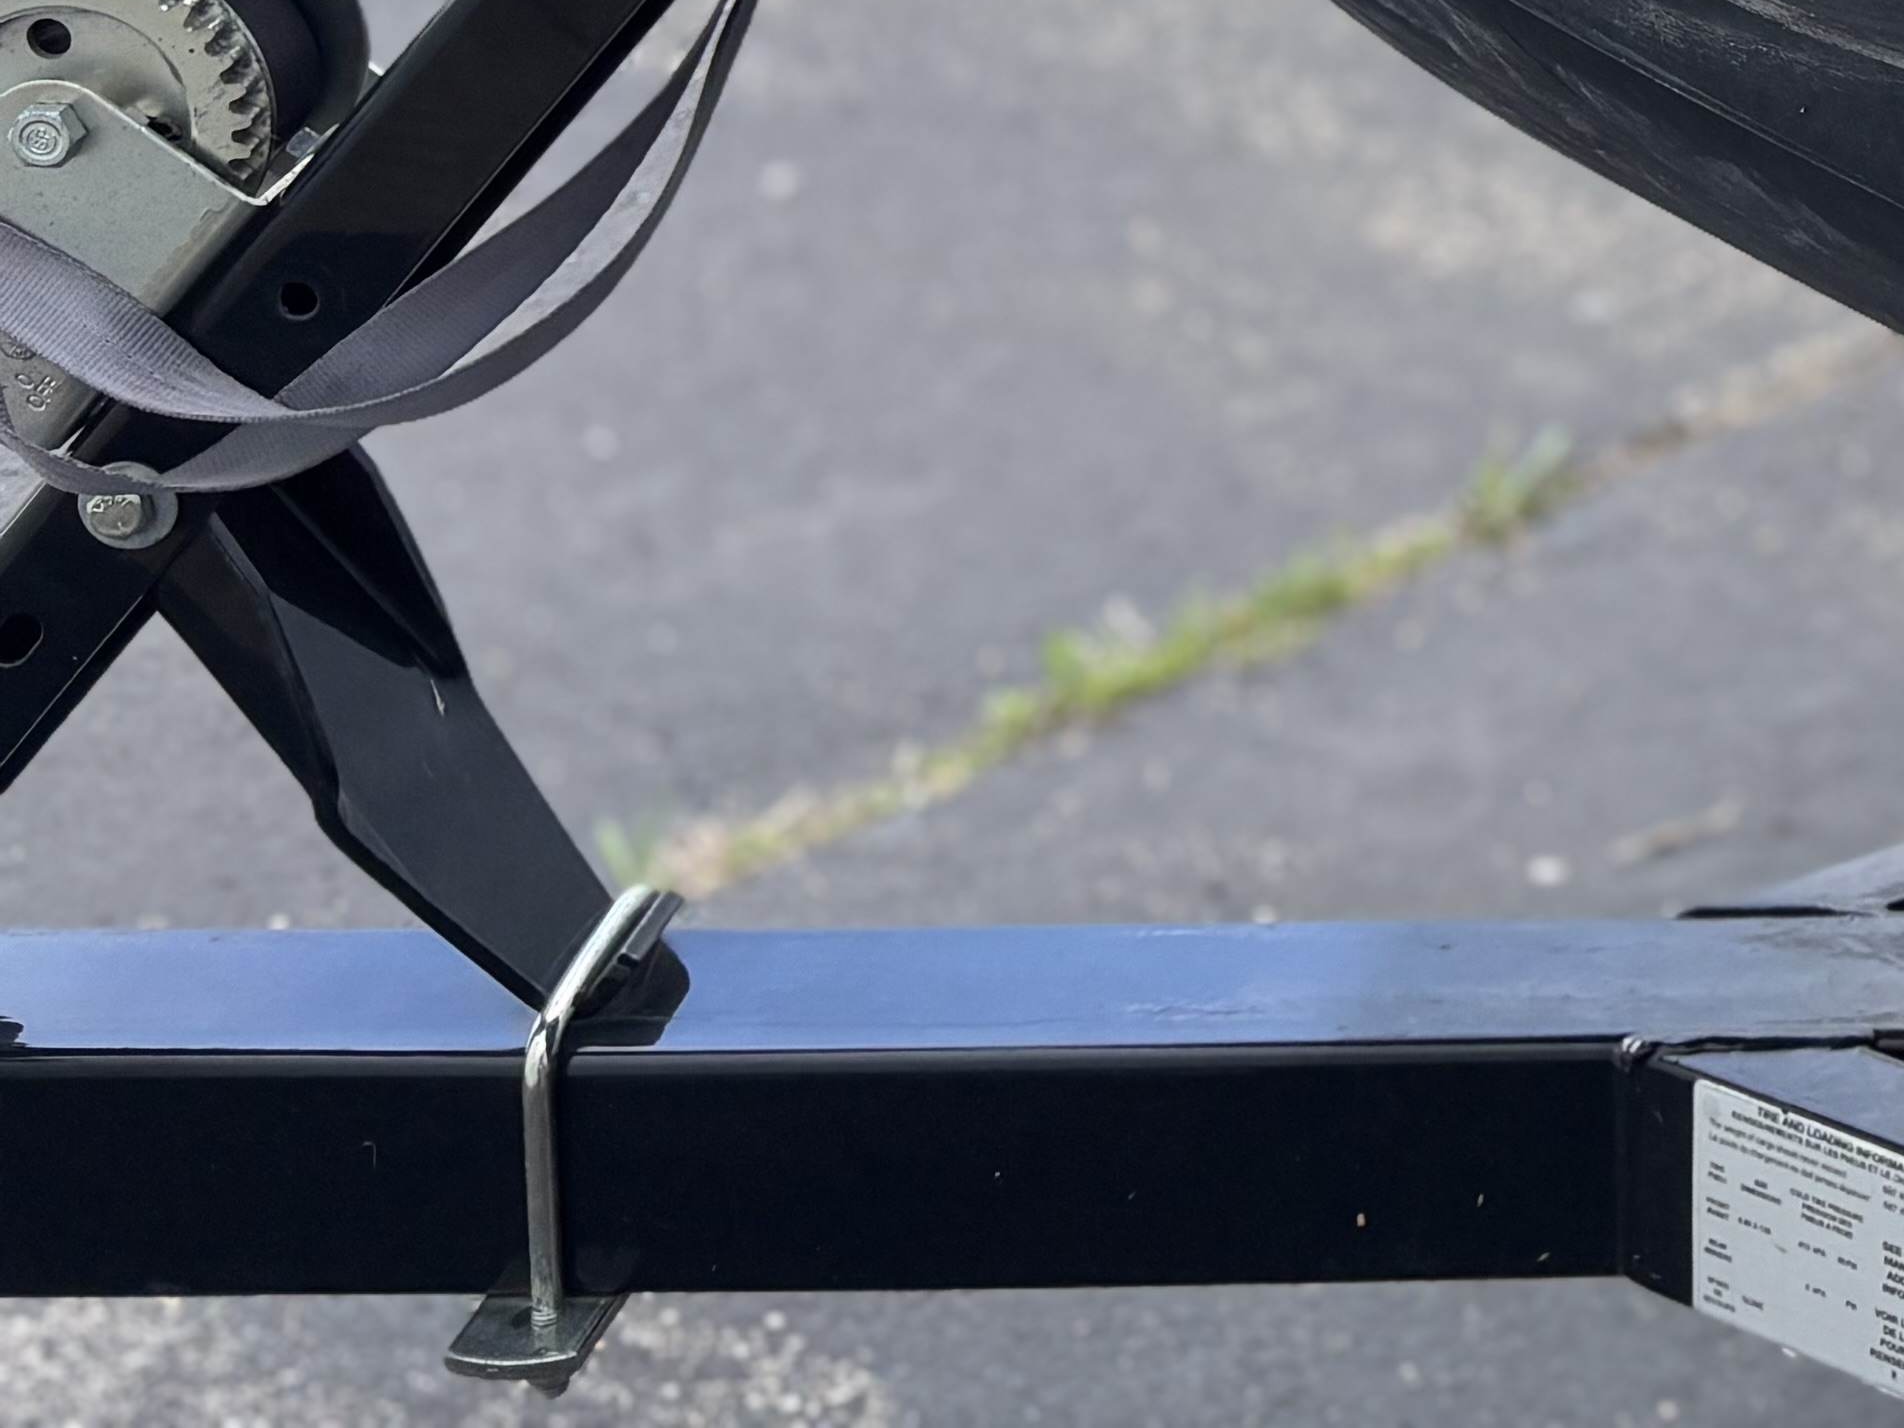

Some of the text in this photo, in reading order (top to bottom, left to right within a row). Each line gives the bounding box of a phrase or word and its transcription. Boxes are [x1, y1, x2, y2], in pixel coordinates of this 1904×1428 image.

[1757, 1106, 1779, 1124] TIRE
[1782, 1115, 1804, 1134] AND
[1806, 1125, 1853, 1153] LOADING
